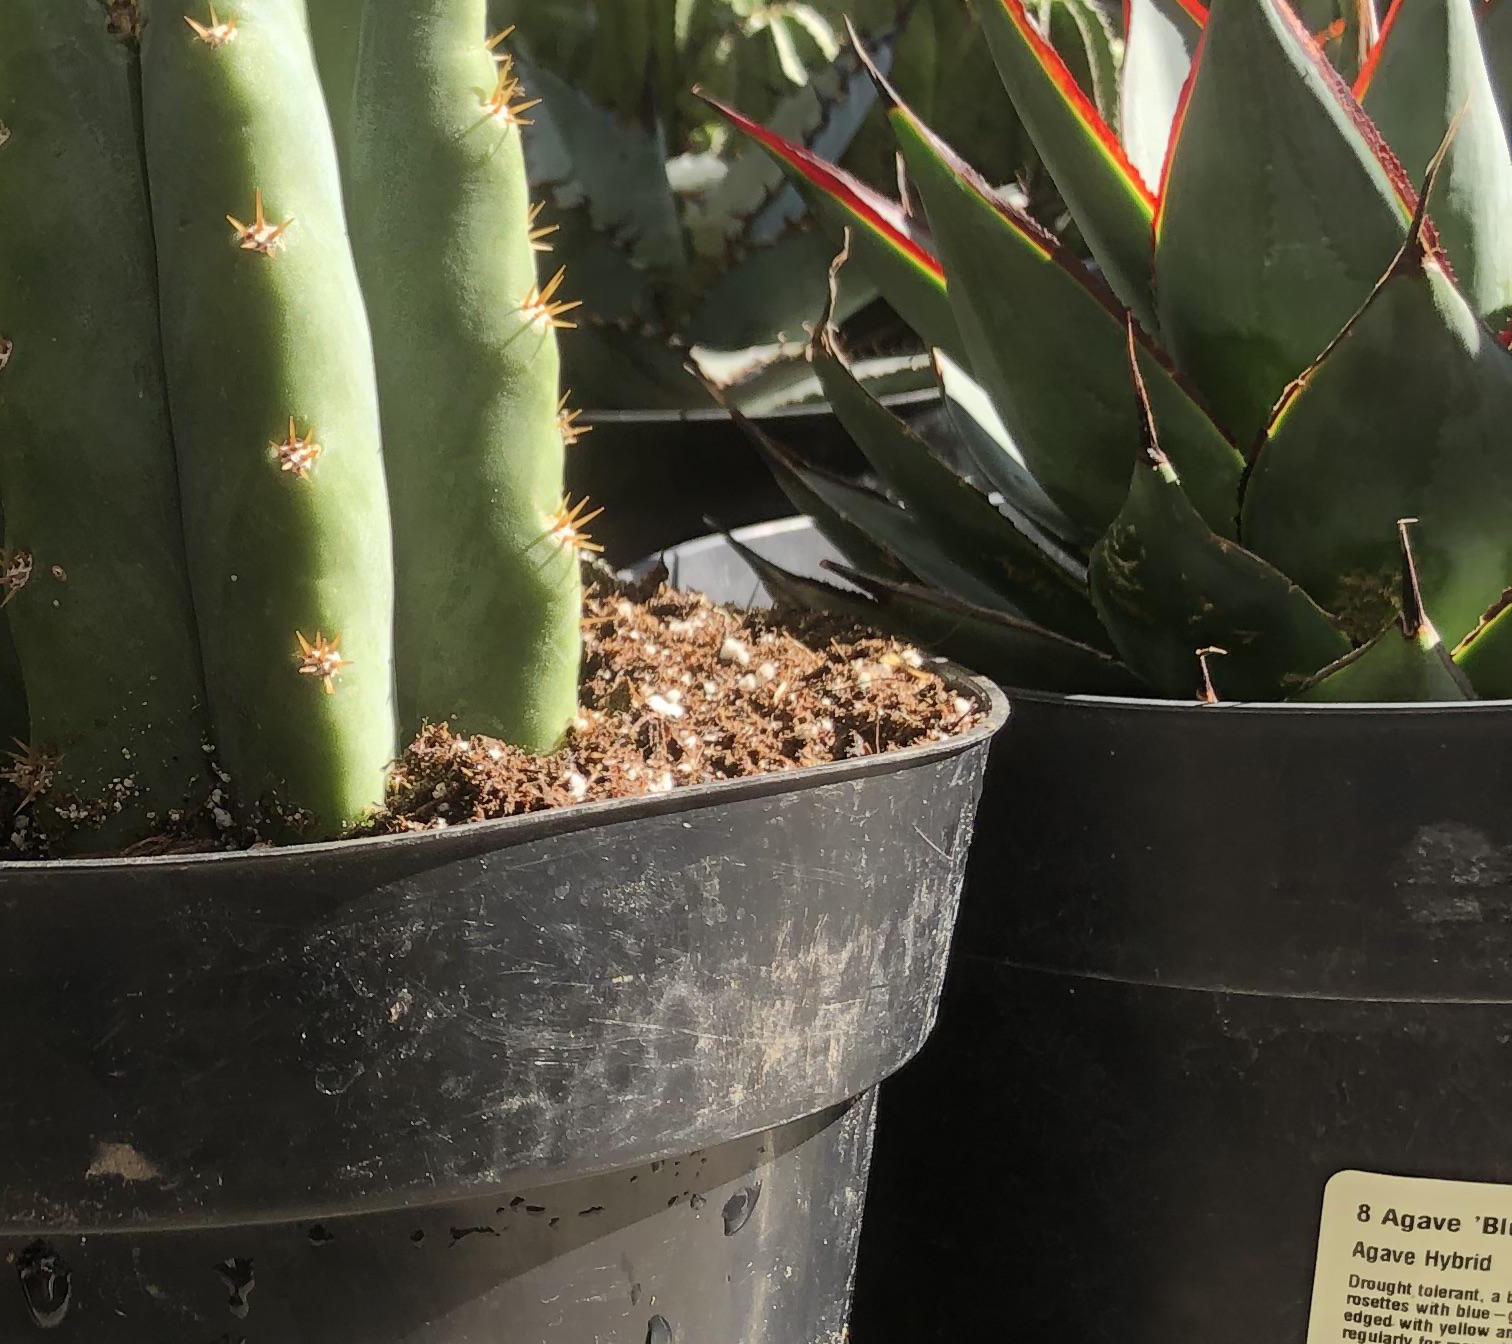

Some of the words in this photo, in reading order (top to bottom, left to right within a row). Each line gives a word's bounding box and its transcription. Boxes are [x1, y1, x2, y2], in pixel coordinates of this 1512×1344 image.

[1356, 1204, 1371, 1223] 8
[1380, 1207, 1461, 1233] Agave
[1352, 1241, 1416, 1266] Agave
[1425, 1249, 1492, 1272] Hybrid
[1348, 1273, 1412, 1296] Drought
[1490, 1291, 1501, 1303] a
[1346, 1293, 1409, 1313] rosettes
[1416, 1302, 1450, 1317] with
[1343, 1310, 1393, 1328] edged
[1399, 1317, 1433, 1333] with
[1439, 1321, 1490, 1337] yellow
